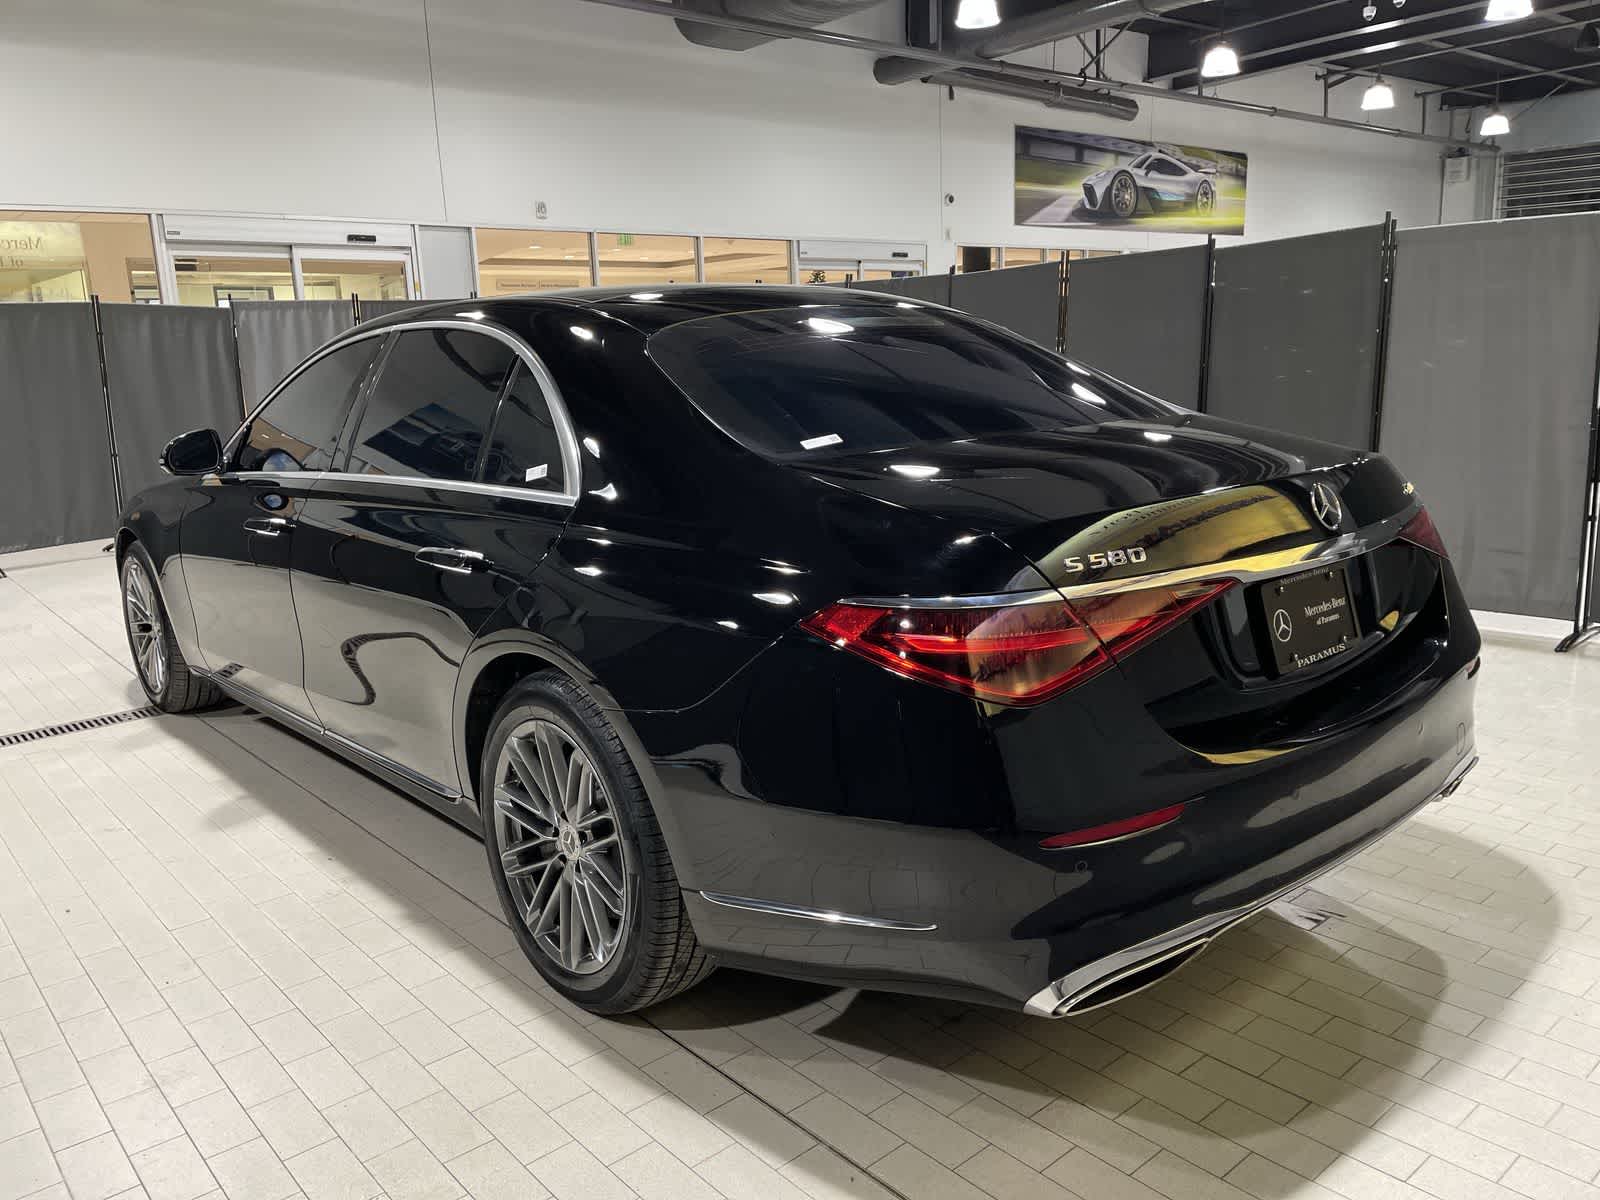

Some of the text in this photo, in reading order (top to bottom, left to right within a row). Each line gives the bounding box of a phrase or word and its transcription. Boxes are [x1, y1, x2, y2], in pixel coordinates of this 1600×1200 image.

[1063, 547, 1147, 573] S 580
[1304, 597, 1346, 617] Mercedes-Benz
[1296, 643, 1346, 668] PARAMUS
